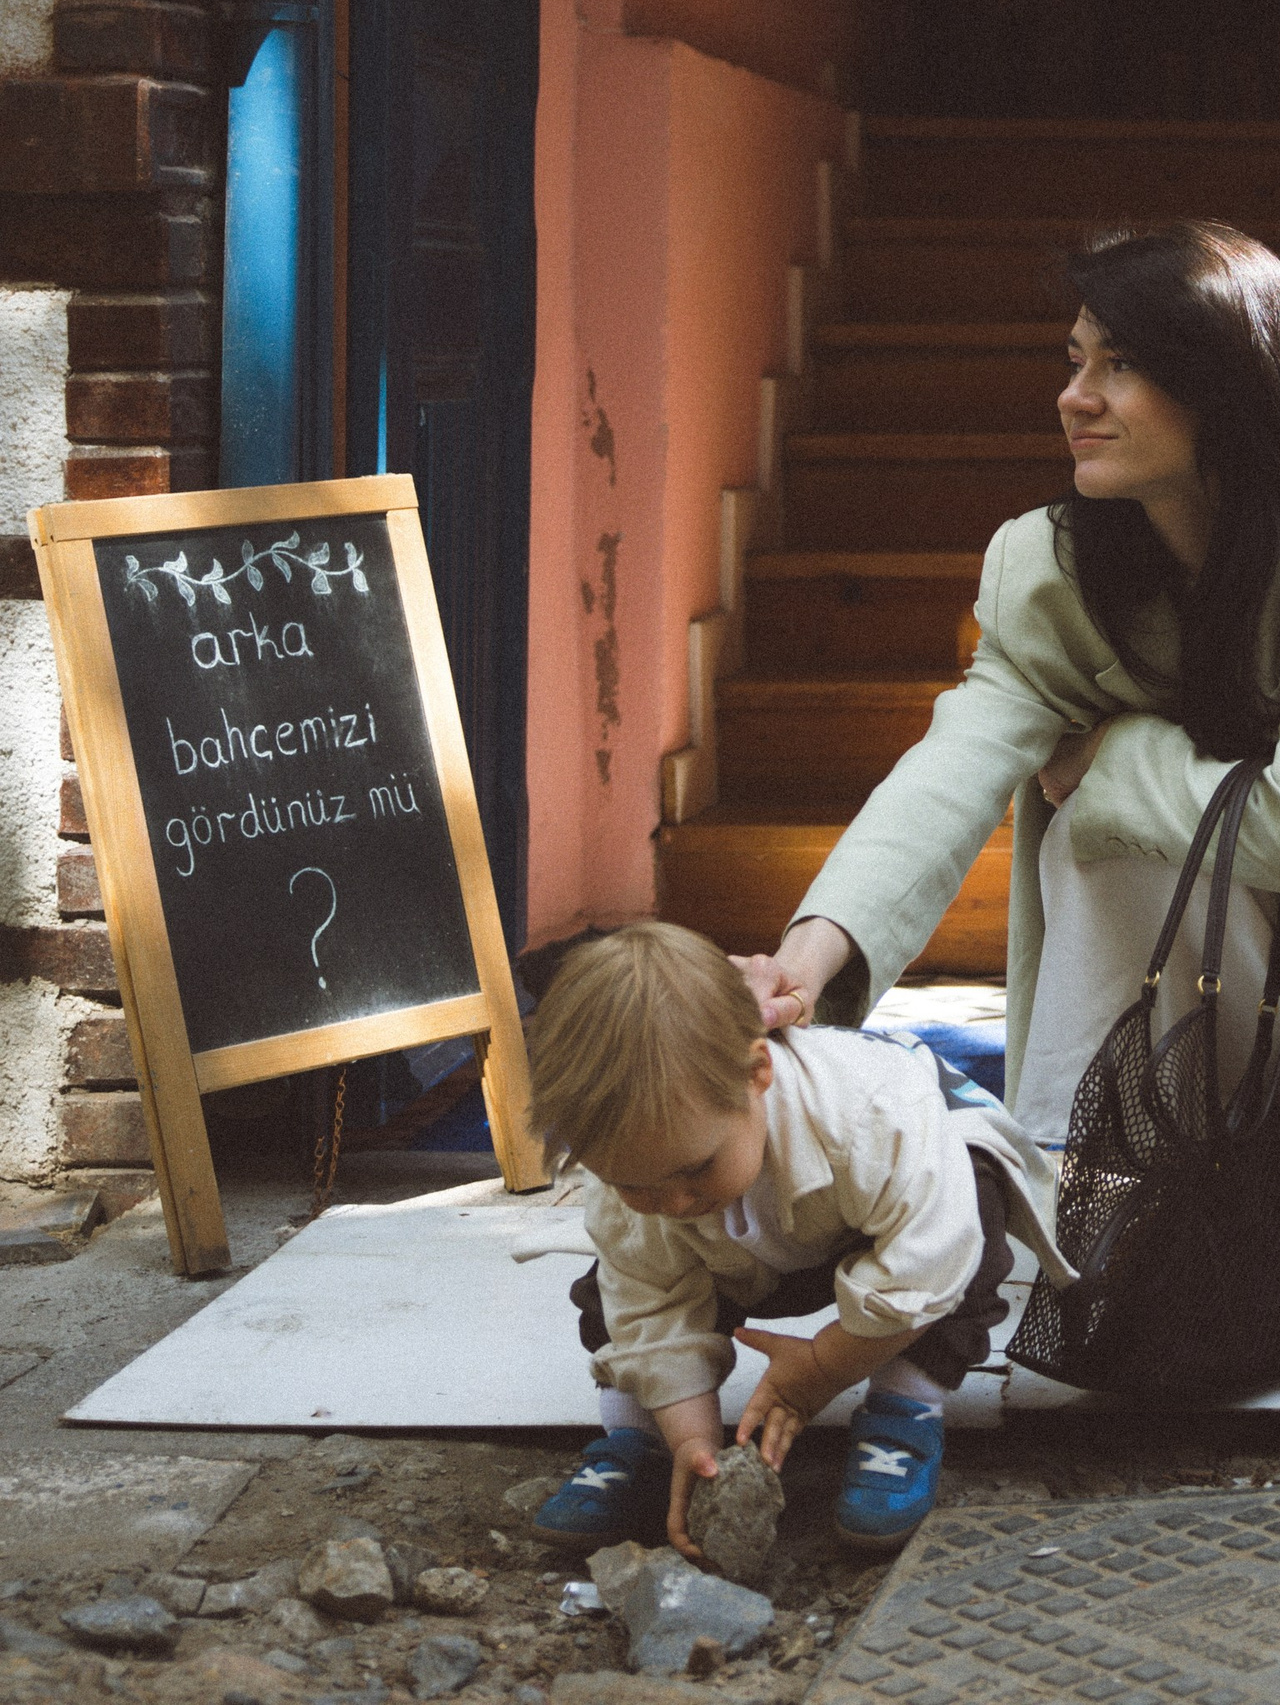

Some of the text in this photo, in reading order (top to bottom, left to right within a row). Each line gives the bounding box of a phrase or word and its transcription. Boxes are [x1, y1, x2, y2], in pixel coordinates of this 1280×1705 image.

[190, 612, 314, 670] arka
[166, 702, 379, 776] bahçemizi
[166, 772, 422, 877] gördünüz mü
[290, 867, 339, 989] ?
